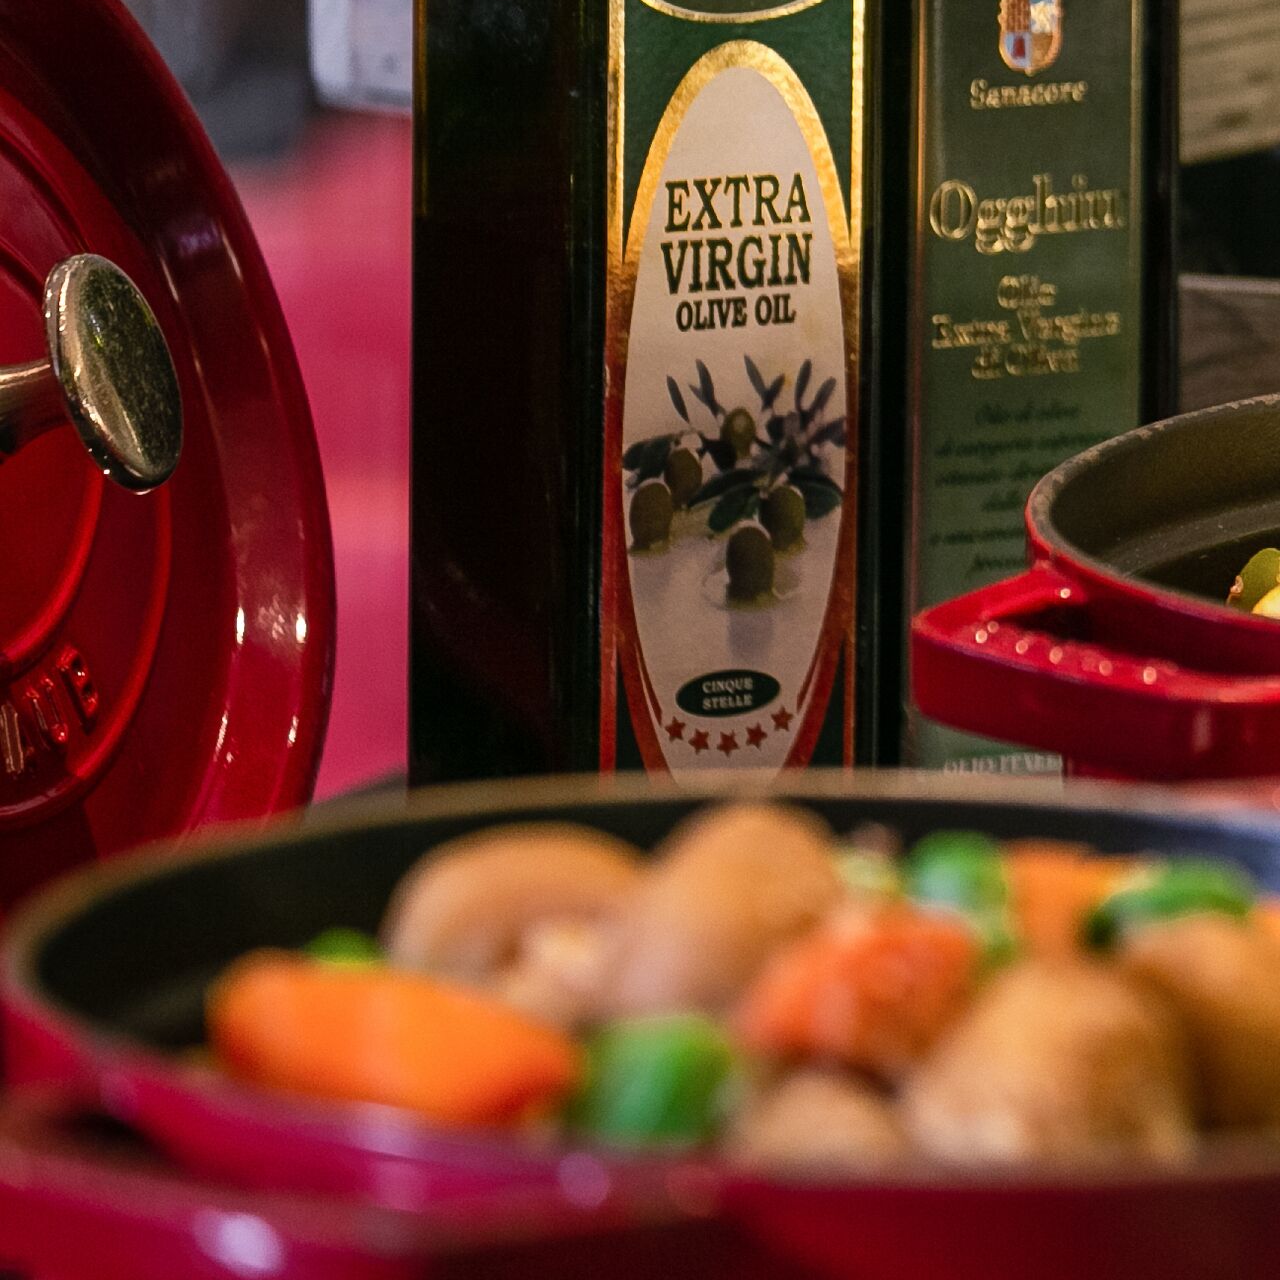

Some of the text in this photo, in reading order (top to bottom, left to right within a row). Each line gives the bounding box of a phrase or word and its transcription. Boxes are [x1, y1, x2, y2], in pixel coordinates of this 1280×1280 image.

[970, 79, 1089, 110] Sanacore
[664, 172, 812, 233] EXTRA
[660, 233, 813, 294] VIRGIN
[675, 293, 797, 332] OLIVE OIL
[701, 677, 754, 694] CINQUE
[701, 694, 753, 711] STELLE
